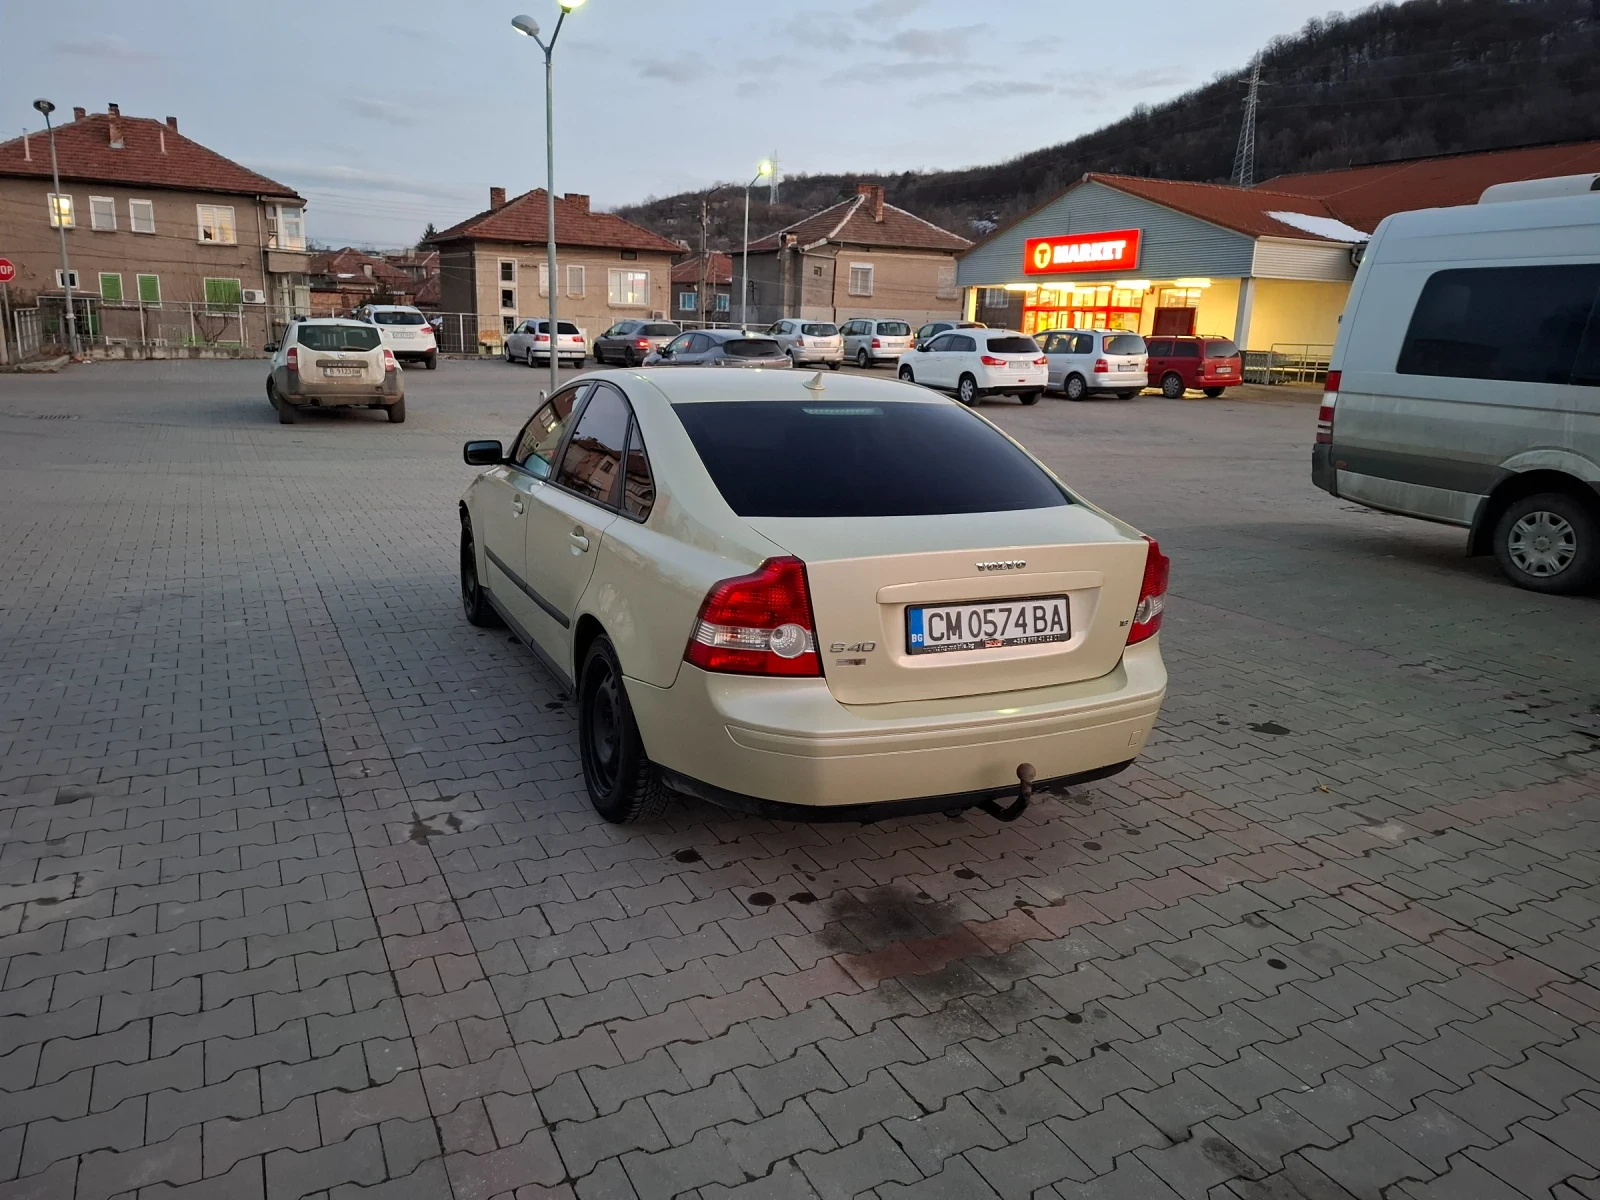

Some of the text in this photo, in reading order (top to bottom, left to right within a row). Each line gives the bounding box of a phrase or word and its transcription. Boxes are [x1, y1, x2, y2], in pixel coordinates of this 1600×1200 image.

[1053, 240, 1126, 264] MARKET
[0, 265, 13, 275] OP
[975, 560, 1026, 571] VOLVO
[911, 633, 923, 643] BG
